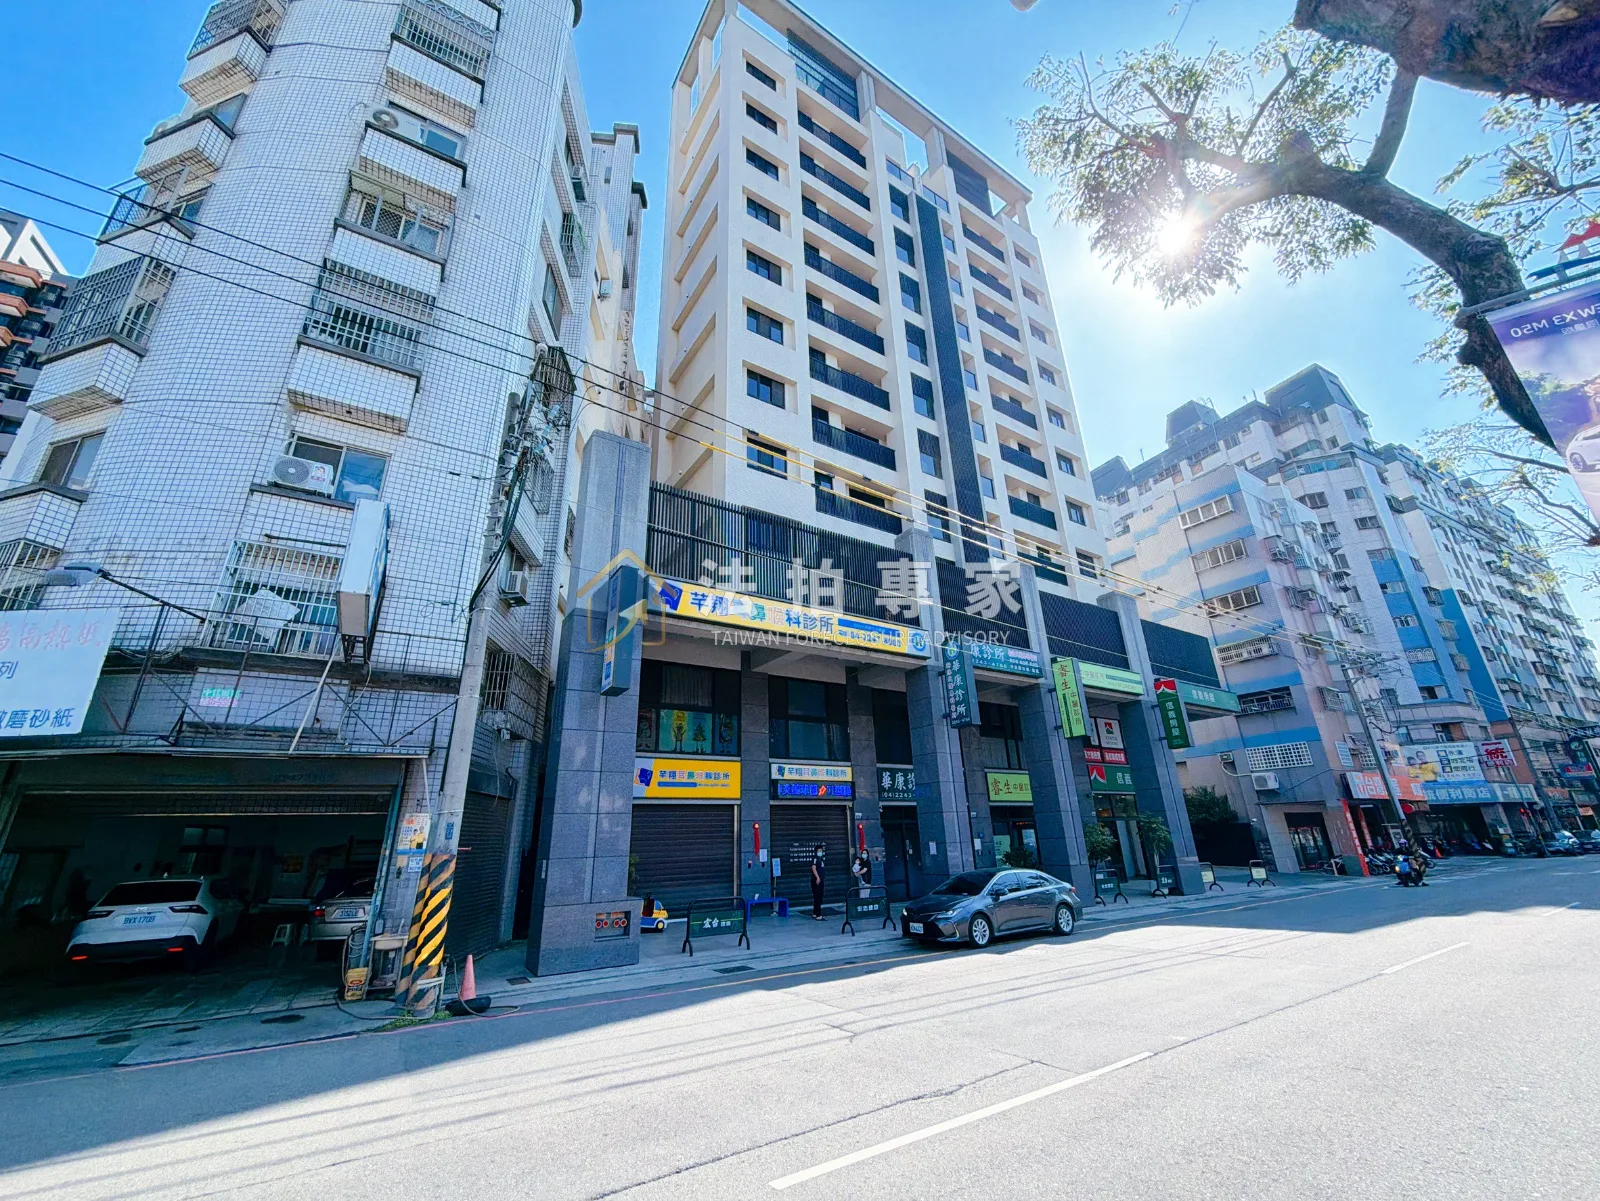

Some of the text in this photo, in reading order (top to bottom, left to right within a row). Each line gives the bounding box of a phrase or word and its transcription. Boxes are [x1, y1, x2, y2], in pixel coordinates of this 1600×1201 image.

[951, 659, 967, 716] 華康診所
[1165, 701, 1181, 737] 信義房屋
